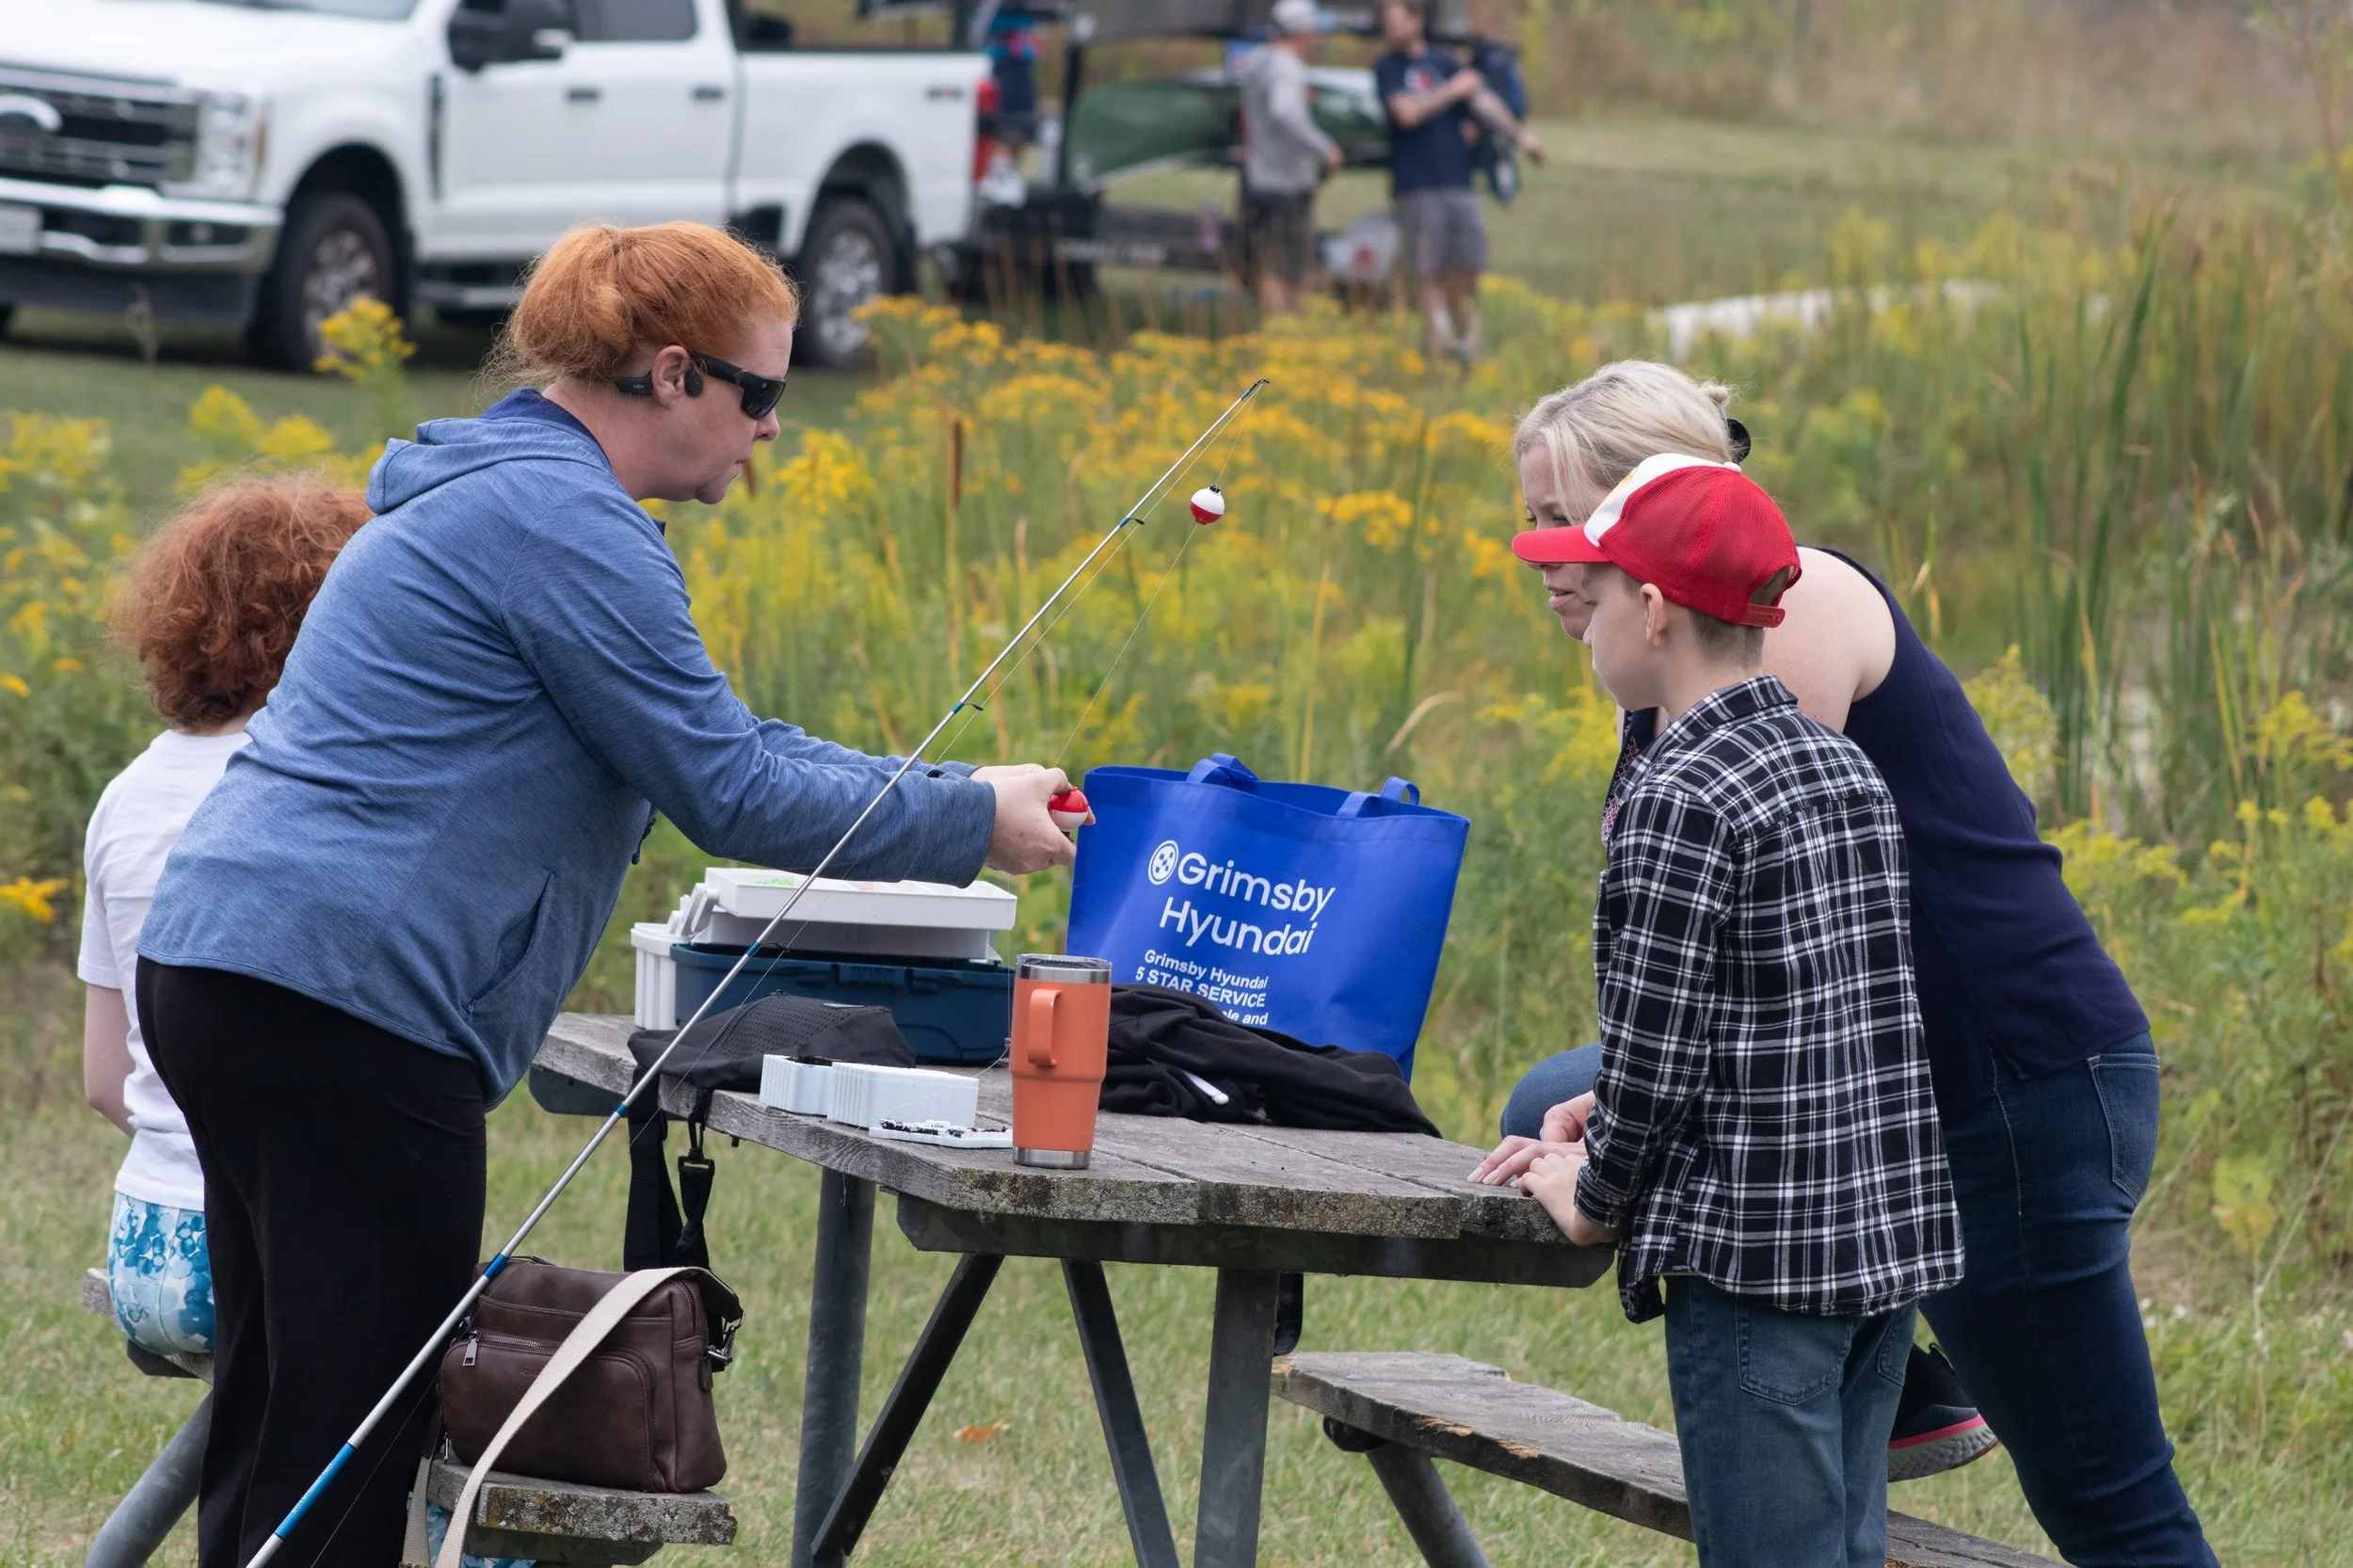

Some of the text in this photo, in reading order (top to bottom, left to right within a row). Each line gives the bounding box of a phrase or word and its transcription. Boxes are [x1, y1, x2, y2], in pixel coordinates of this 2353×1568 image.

[1177, 853, 1336, 921] Grimsby
[1160, 896, 1318, 955] Hyundai
[1135, 966, 1266, 1007] 5 STAR SERVICE
[1144, 949, 1269, 989] Grimsby Hyundai
[1242, 1012, 1269, 1025] and
